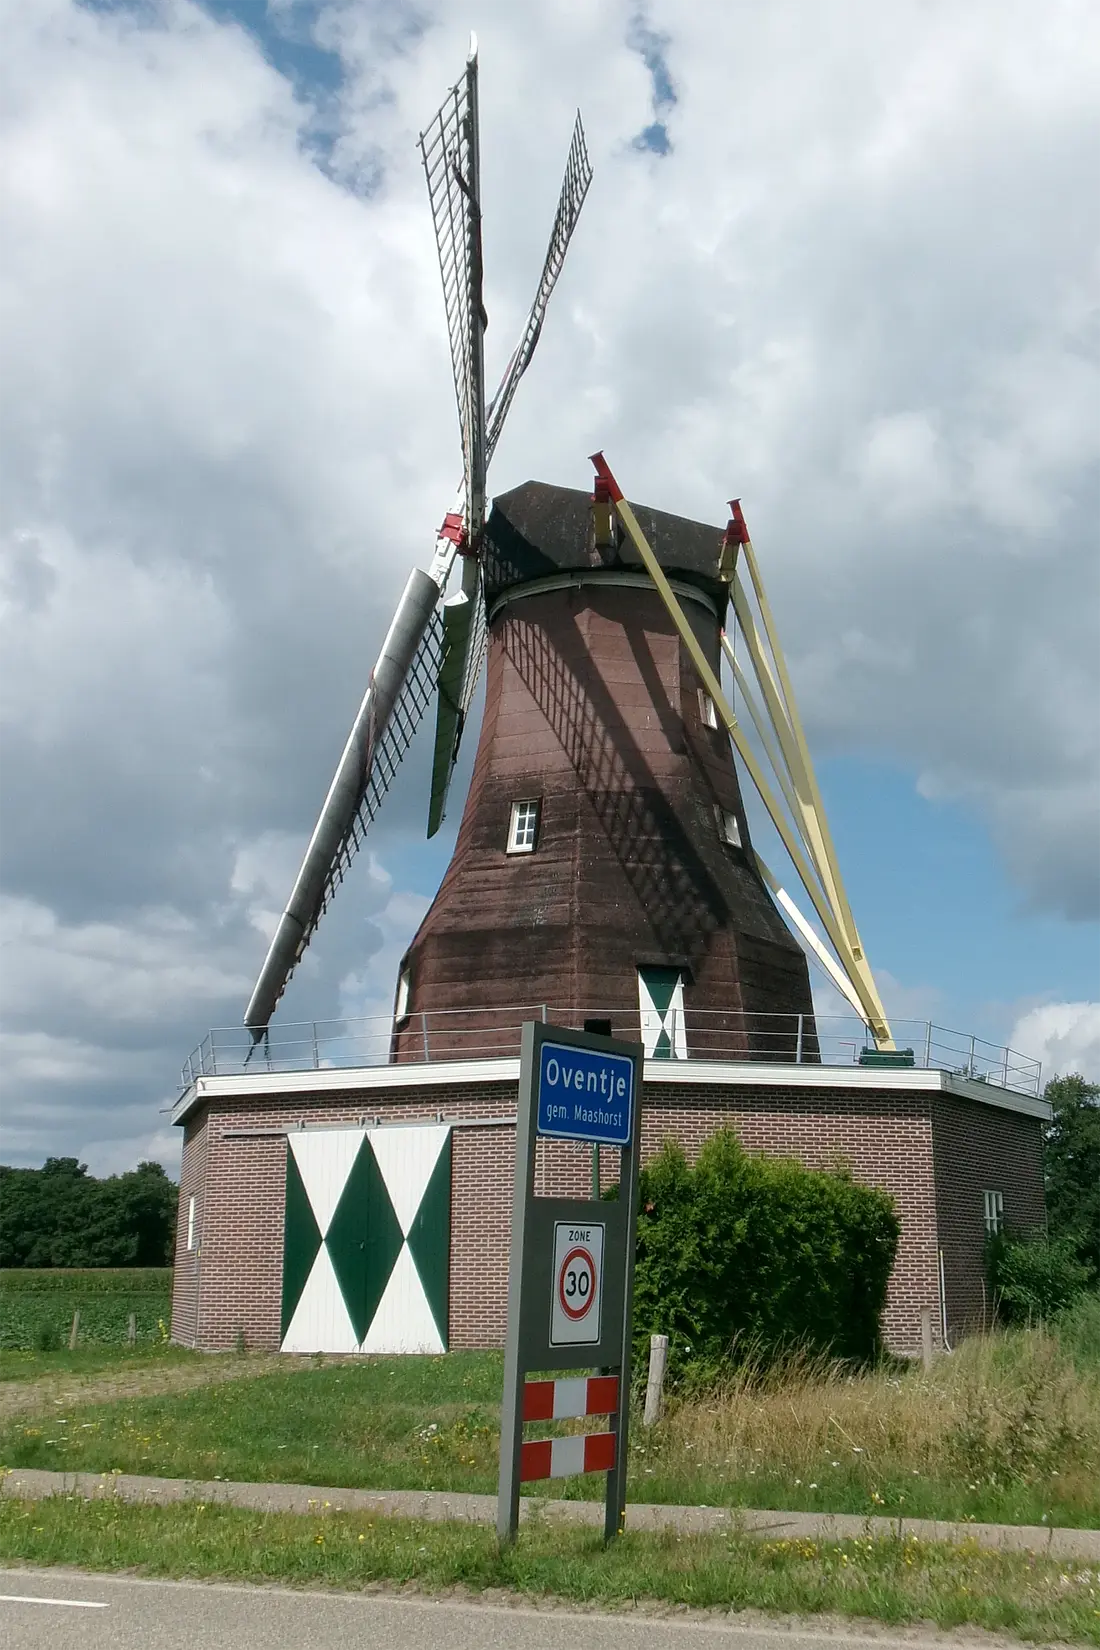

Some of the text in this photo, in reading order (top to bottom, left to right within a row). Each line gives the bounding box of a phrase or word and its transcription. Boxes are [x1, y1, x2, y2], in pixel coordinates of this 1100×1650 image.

[546, 1058, 626, 1103] Oventje
[546, 1104, 622, 1127] gem. Maashorst
[568, 1230, 591, 1242] ZONE
[565, 1271, 590, 1297] 30
